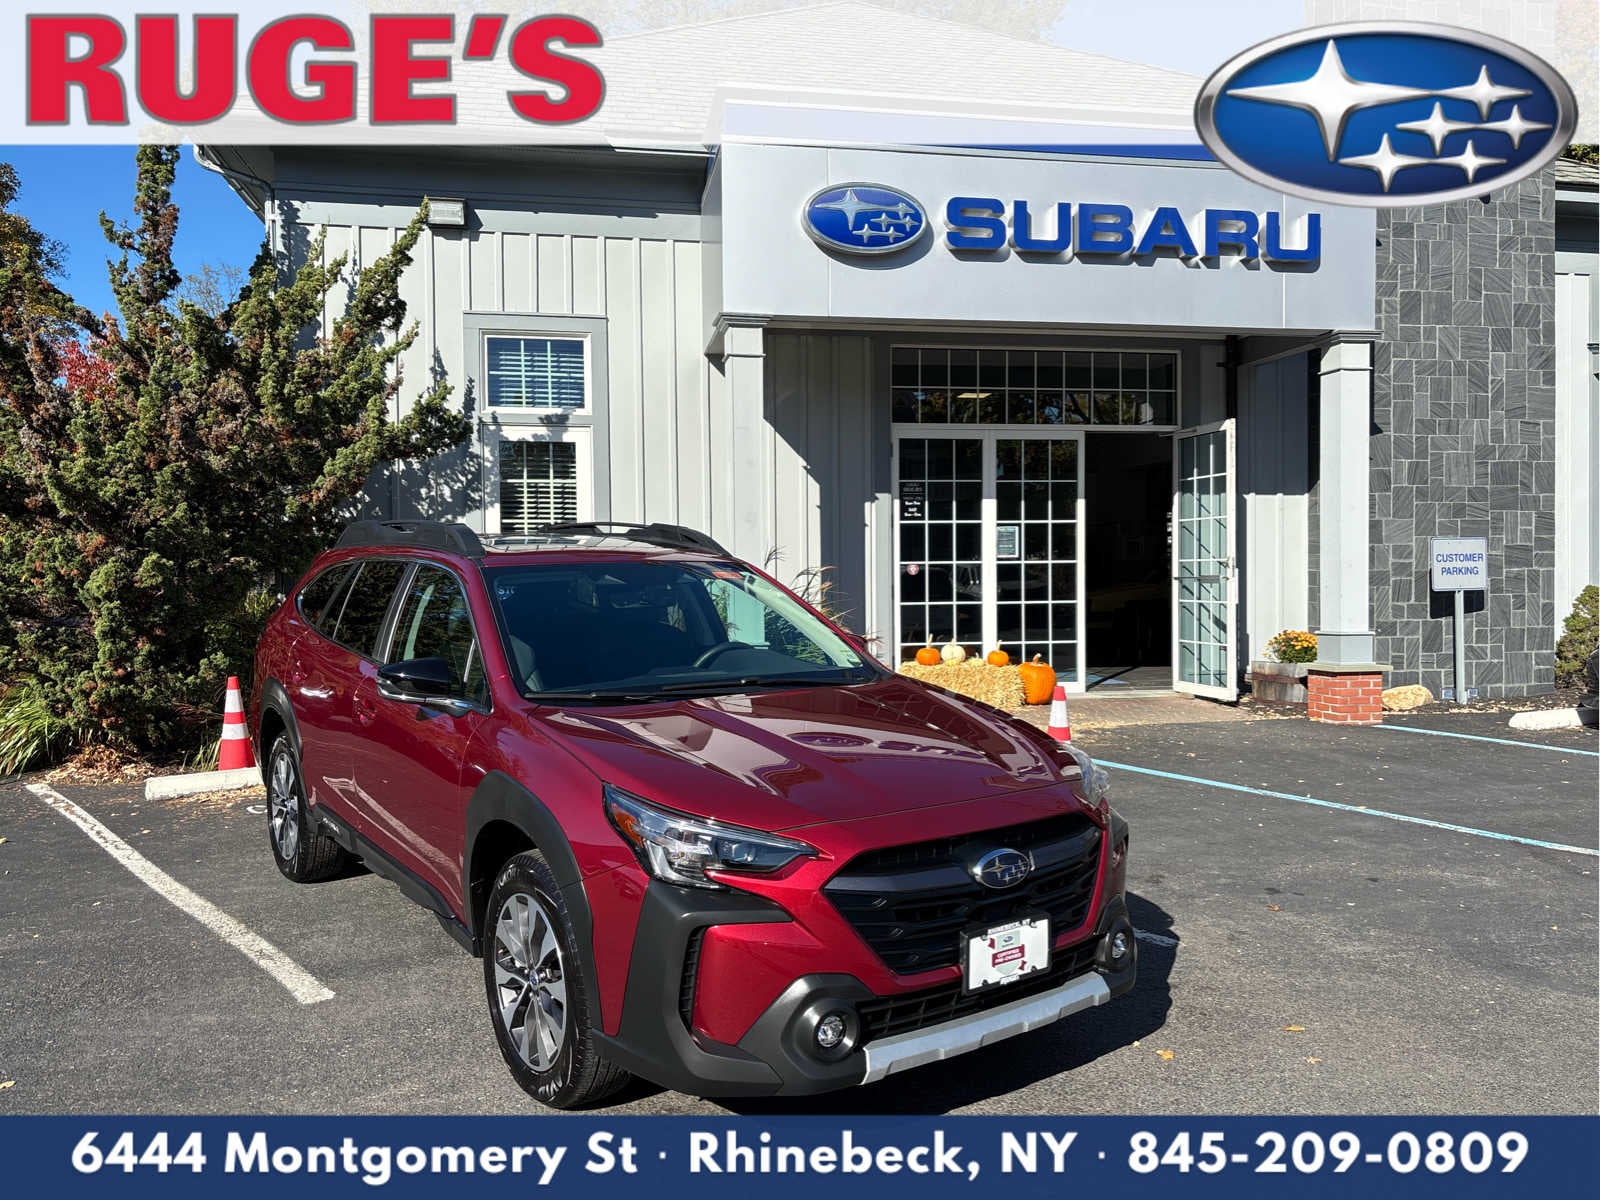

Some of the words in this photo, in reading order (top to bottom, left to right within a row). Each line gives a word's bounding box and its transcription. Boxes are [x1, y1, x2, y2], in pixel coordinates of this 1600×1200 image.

[946, 196, 1321, 264] SUBARU
[1436, 553, 1484, 563] CUSTOMER
[1441, 566, 1479, 576] PARKING
